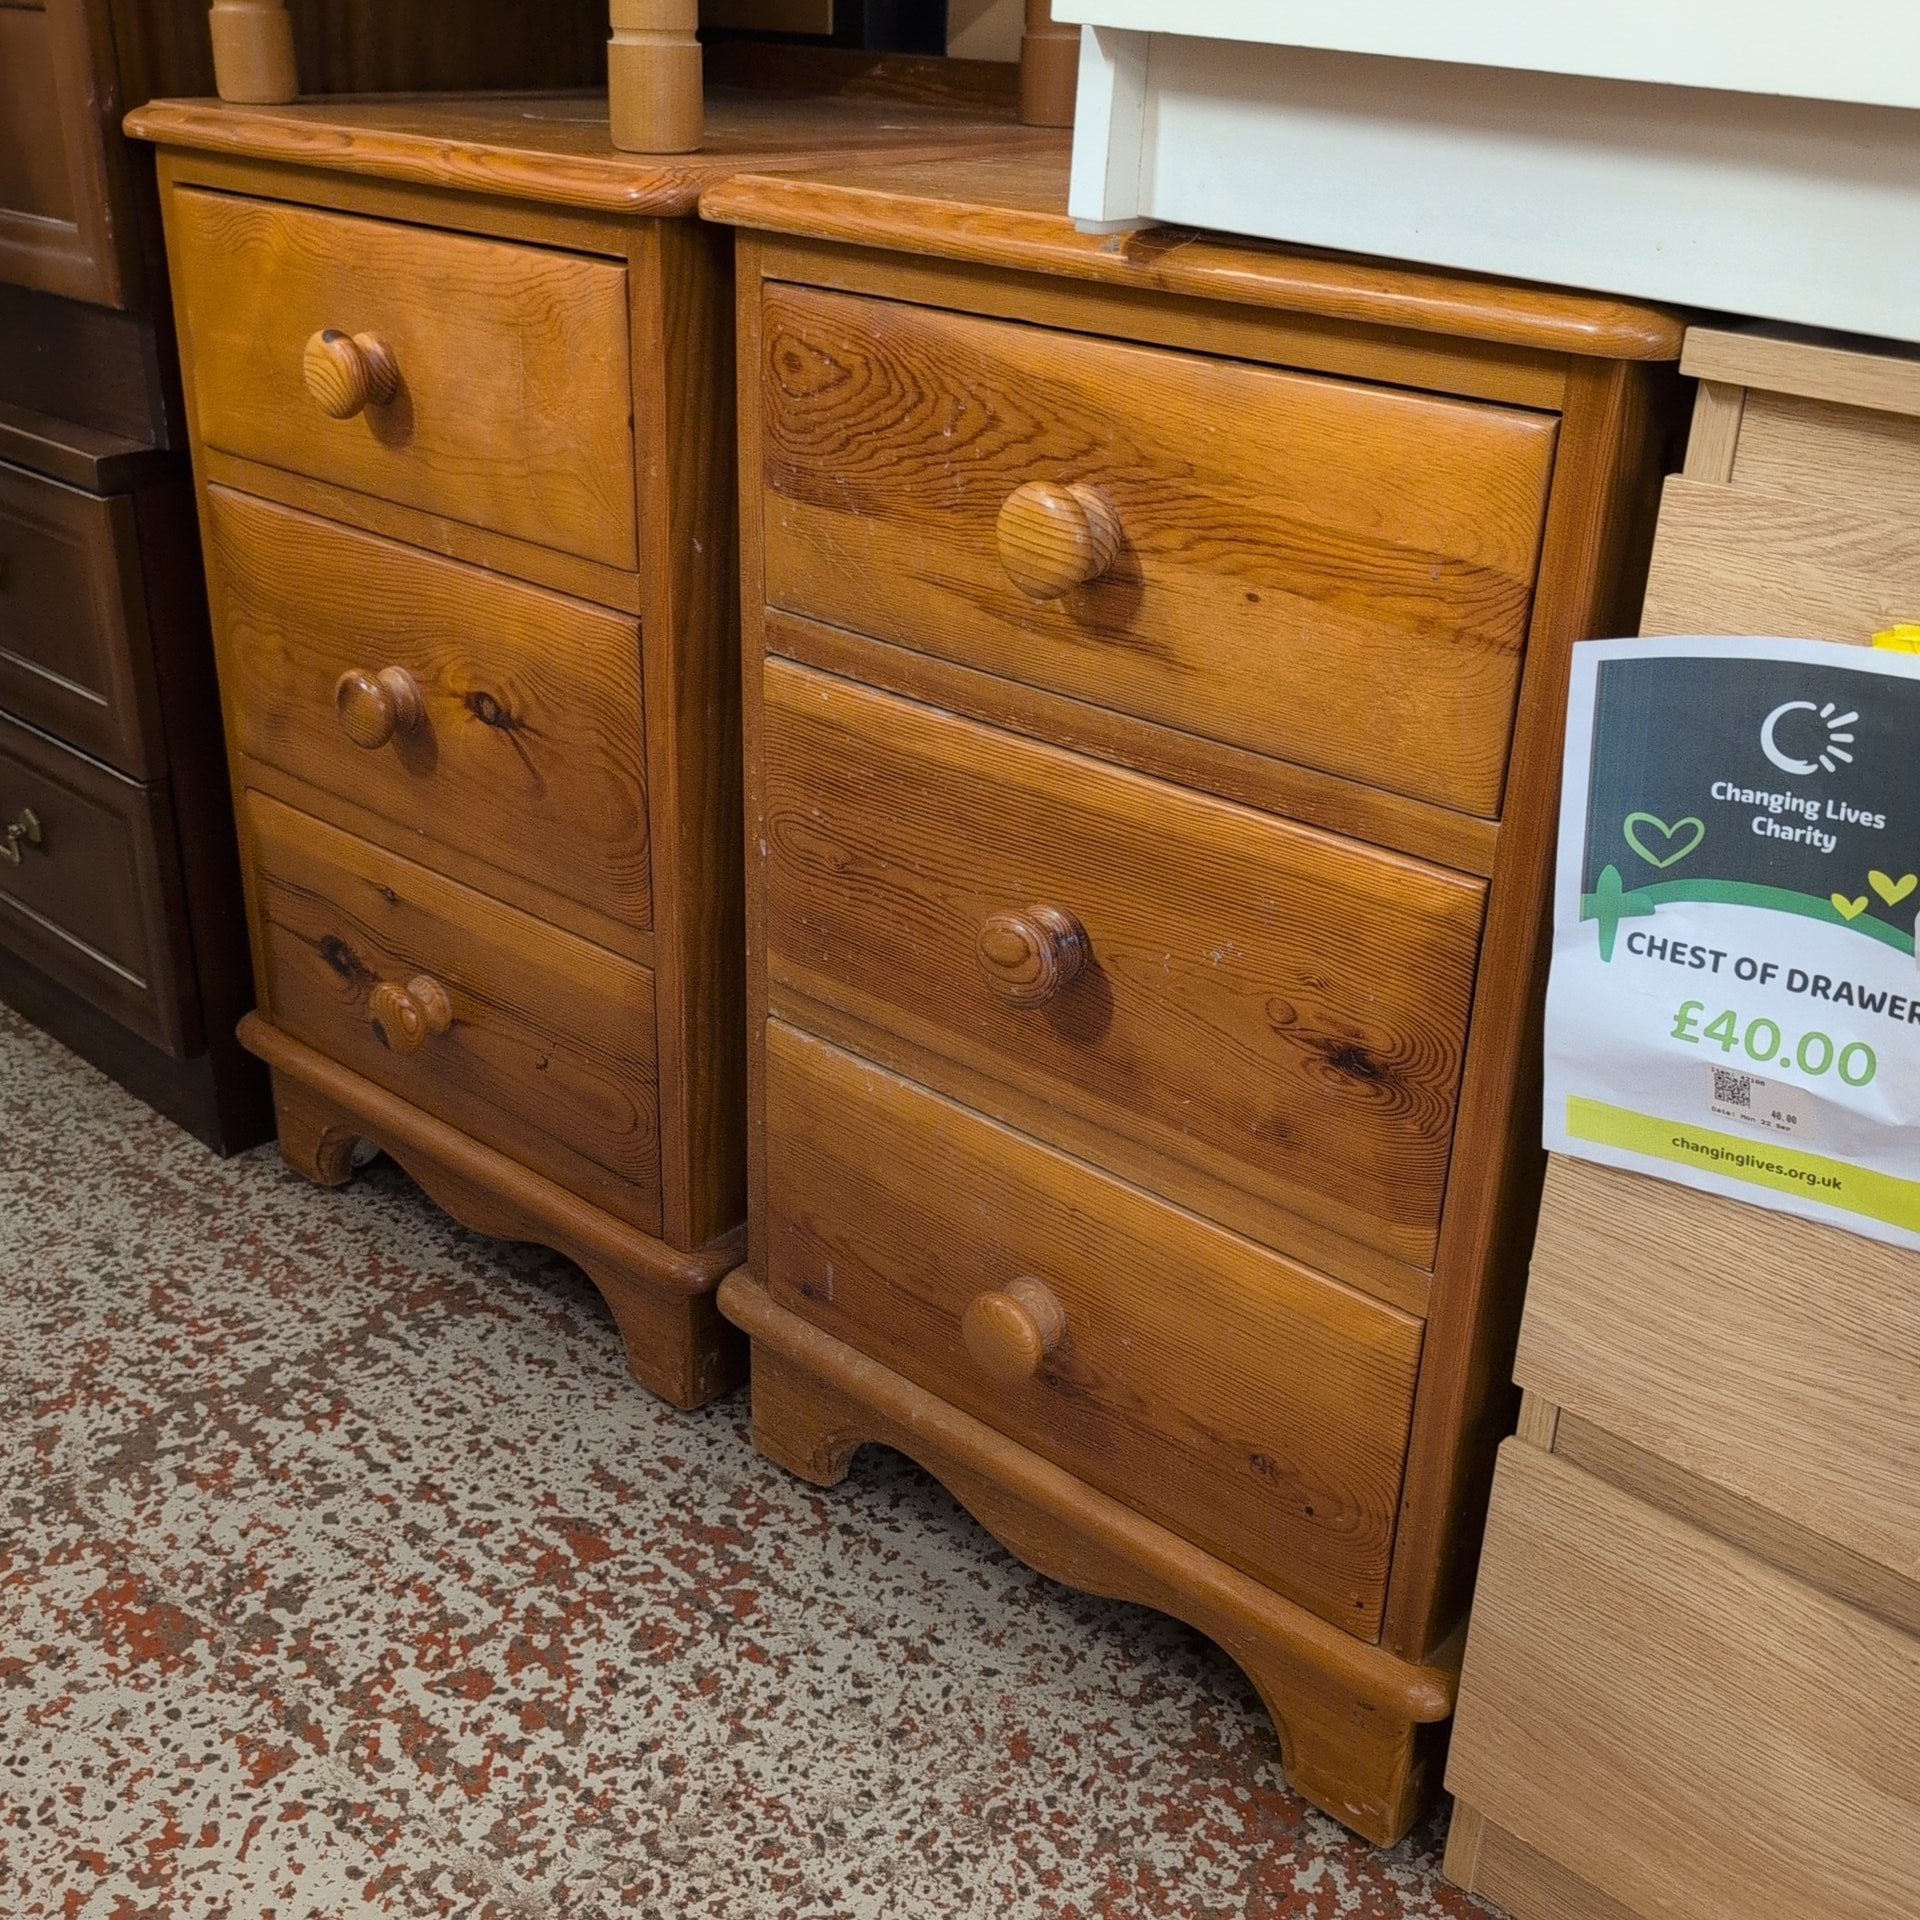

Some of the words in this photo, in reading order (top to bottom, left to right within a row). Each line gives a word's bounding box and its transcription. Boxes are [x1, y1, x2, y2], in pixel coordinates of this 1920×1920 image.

[1711, 781, 1819, 820] Changing
[1826, 798, 1886, 829] Lives
[1751, 816, 1837, 853] Charity
[1627, 931, 1727, 974] CHEST
[1735, 956, 1778, 985] OF
[1787, 968, 1920, 1025] DRAWER
[1670, 1000, 1876, 1086] £40.00
[1711, 1106, 1735, 1116] Date:
[1741, 1114, 1756, 1122] Mon
[1776, 1123, 1791, 1131] Sep
[1771, 1110, 1797, 1124] 40.00
[1671, 1135, 1842, 1191] changinglives.org.uk
